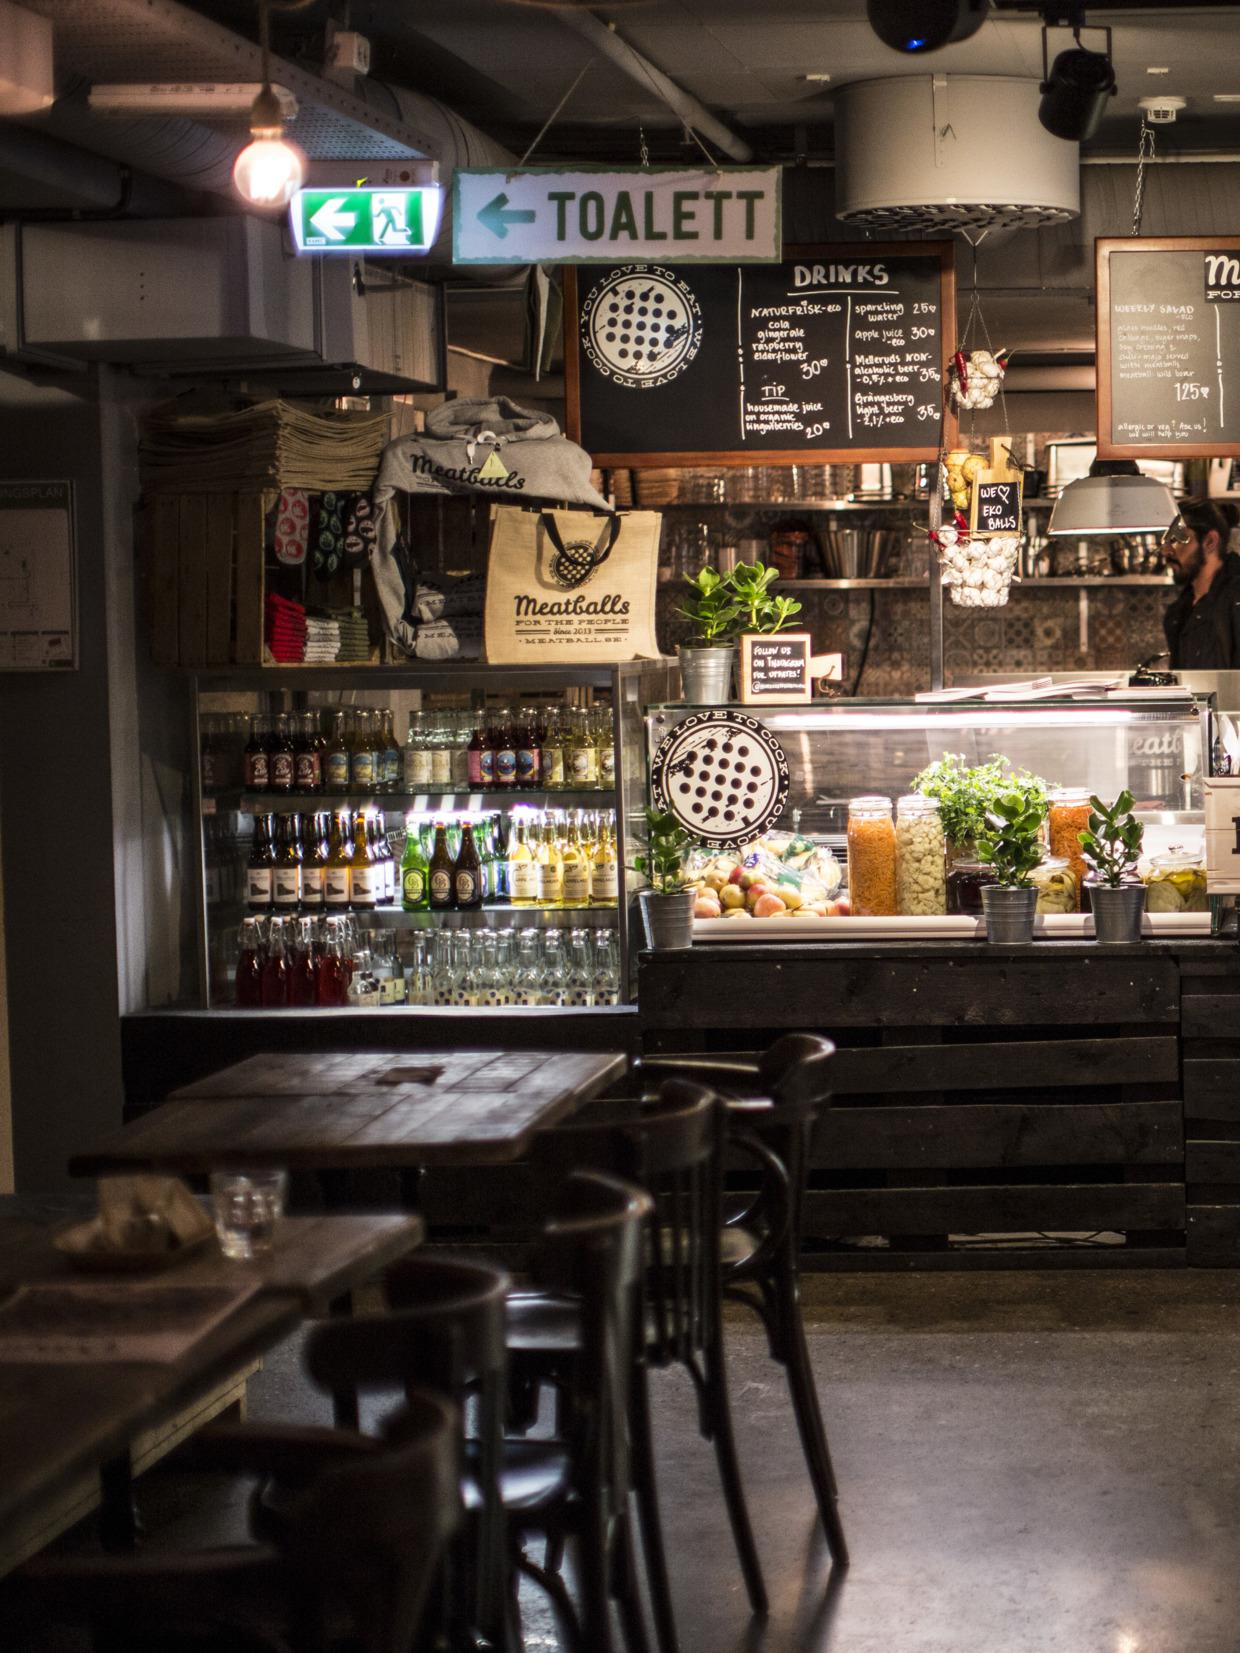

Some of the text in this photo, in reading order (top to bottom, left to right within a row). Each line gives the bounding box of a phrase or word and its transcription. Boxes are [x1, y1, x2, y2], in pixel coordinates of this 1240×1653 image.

[547, 190, 764, 242] TOALETT
[794, 264, 889, 287] DRINKS
[581, 264, 701, 324] YOU LOVE TO EAT
[855, 303, 904, 315] sparkling
[1115, 304, 1194, 314] WEEKLY SALAD
[868, 313, 899, 322] water
[768, 320, 790, 329] cola
[855, 327, 928, 341] apple juice 30
[752, 341, 803, 352] raspberry
[582, 328, 703, 388] WE LOVE TO COOK
[754, 351, 809, 364] elderflower
[855, 354, 901, 365] Melleruds
[800, 361, 820, 380] 30
[854, 365, 896, 375] alcoholic
[898, 365, 920, 373] beer
[1174, 383, 1200, 401] 125
[746, 402, 824, 414] housemade juice
[856, 406, 880, 417] light
[883, 405, 905, 414] beer
[759, 413, 796, 423] organic
[805, 424, 823, 439] 20
[980, 487, 997, 498] WE
[983, 505, 1002, 517] EKO
[988, 515, 1016, 530] BALLS
[514, 594, 630, 616] Meatballs
[573, 627, 592, 635] 2013
[754, 646, 792, 656] FOLLOW US
[653, 711, 789, 776] WE LOVE TO COOK
[765, 789, 789, 830] YOU
[707, 828, 762, 849] LOVE
